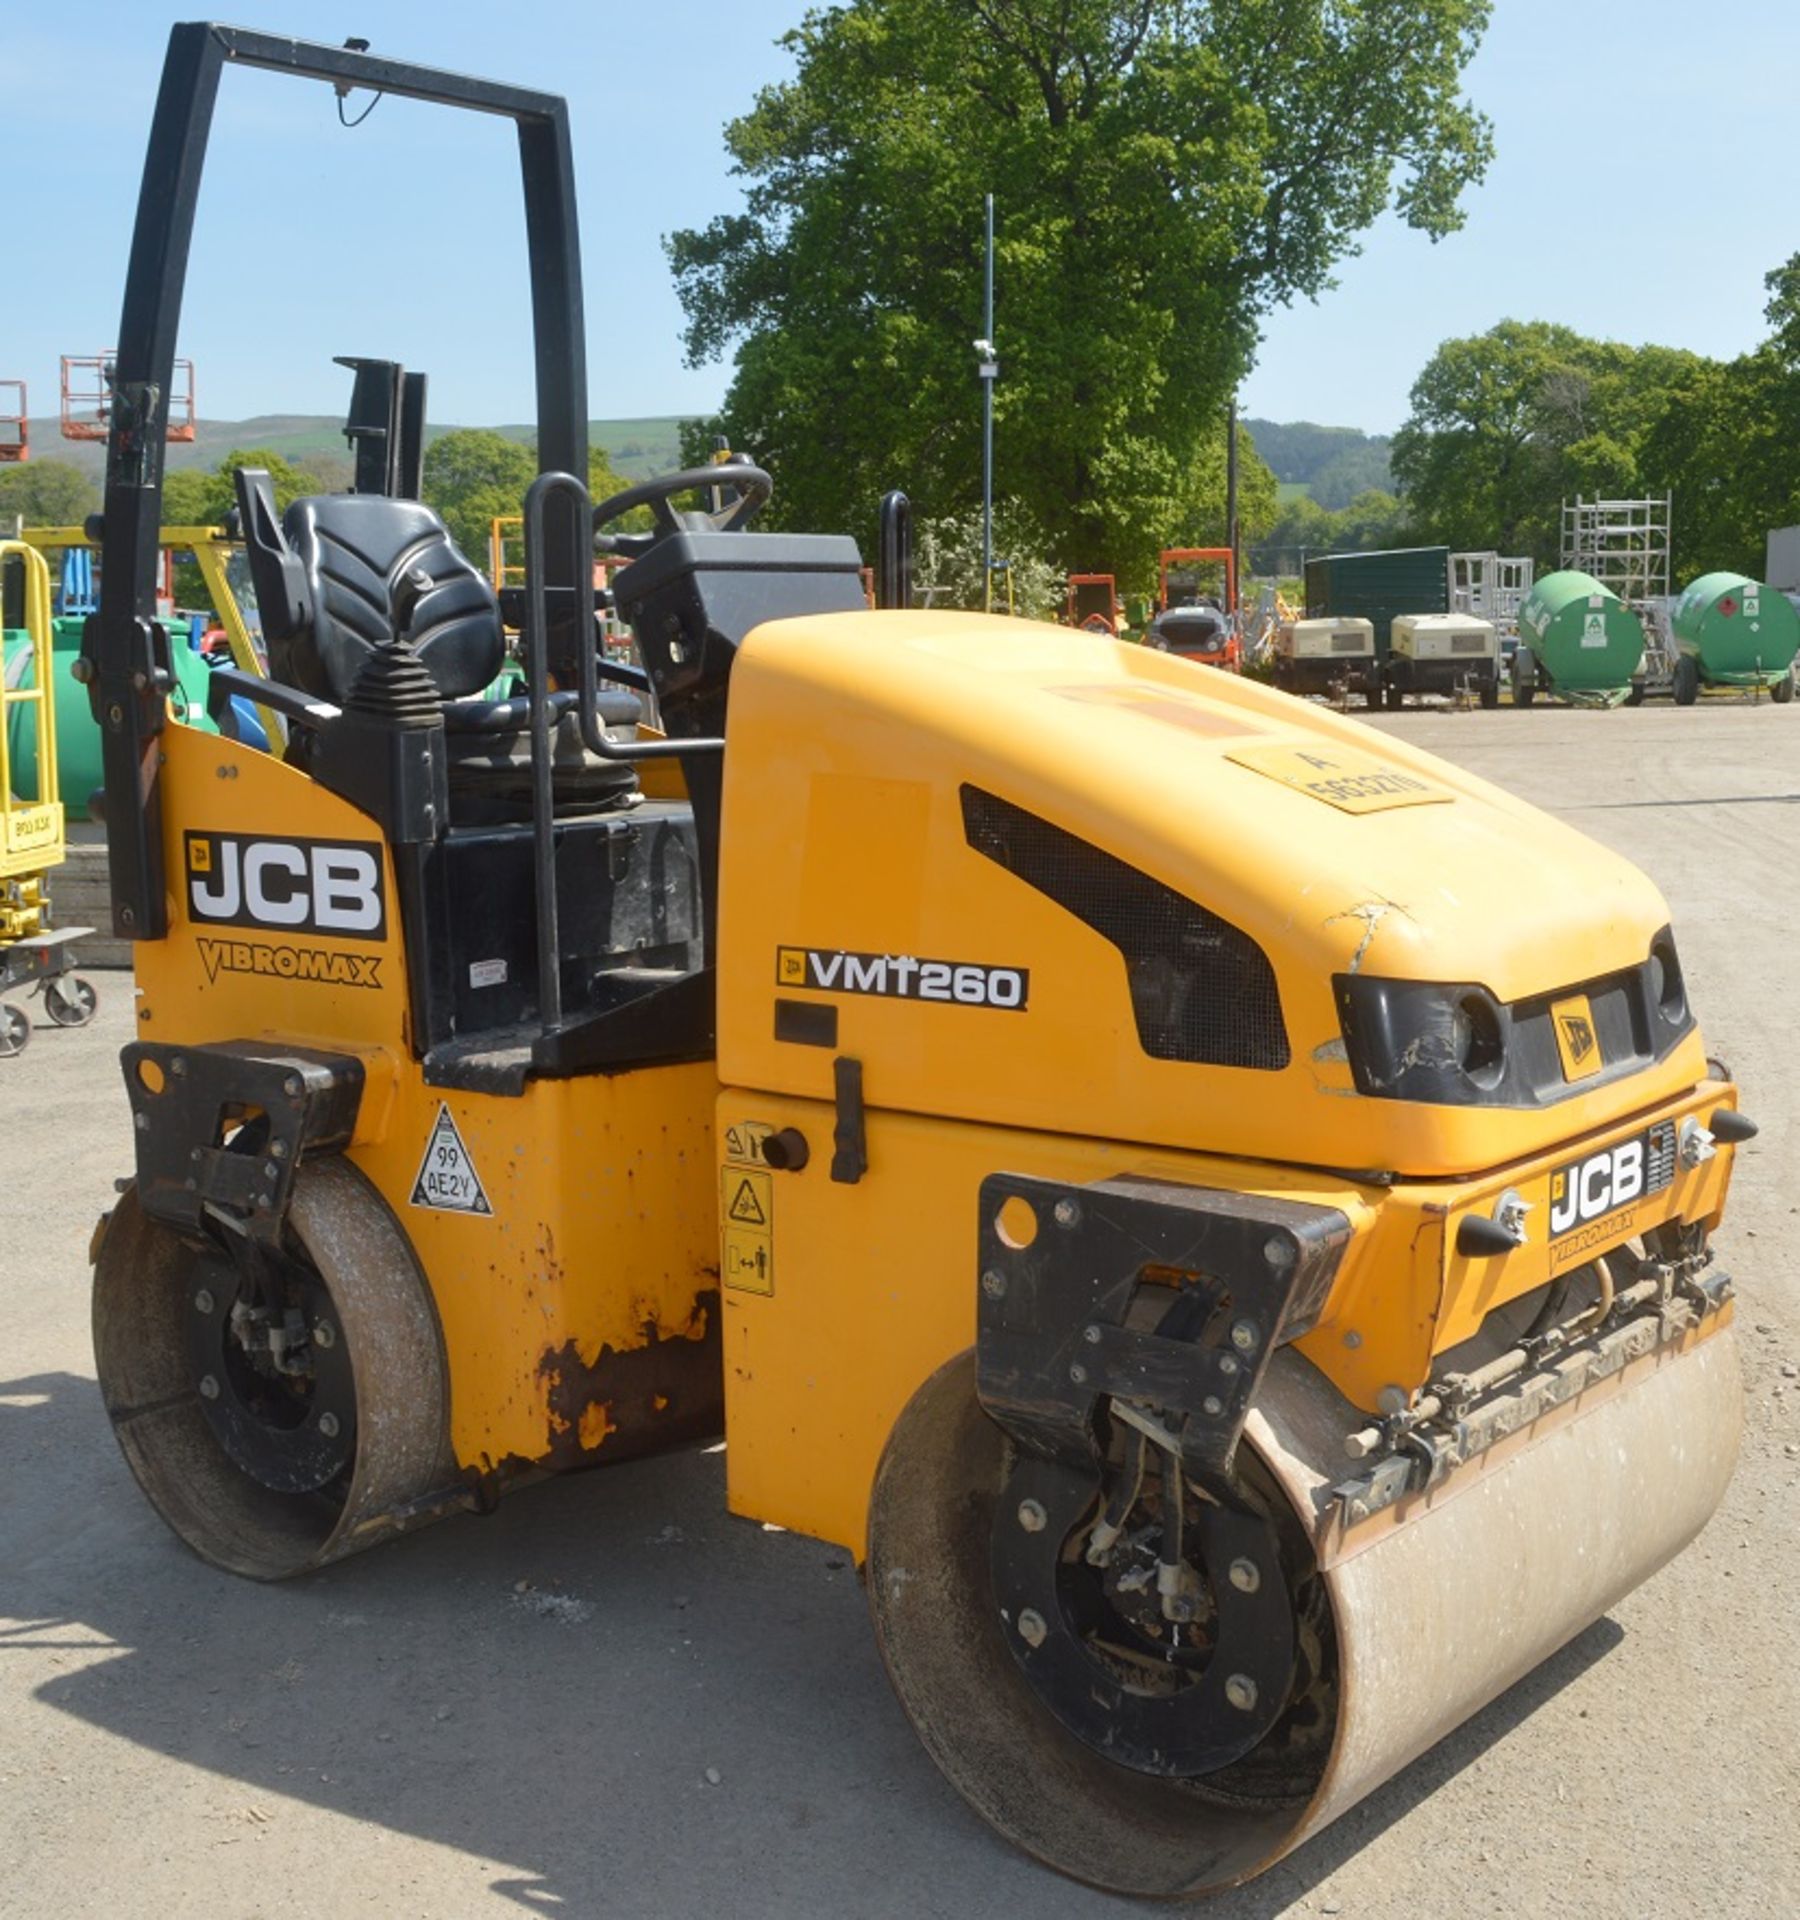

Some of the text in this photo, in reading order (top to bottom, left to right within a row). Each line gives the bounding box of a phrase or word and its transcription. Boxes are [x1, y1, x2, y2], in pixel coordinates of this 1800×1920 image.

[1295, 752, 1341, 769] A
[191, 840, 382, 931] JCB
[196, 937, 383, 989] VIBROMAX
[808, 952, 1022, 1007] VMT260
[437, 1146, 459, 1169] 99
[428, 1172, 470, 1198] AE2Y
[1551, 1139, 1643, 1233] JCB
